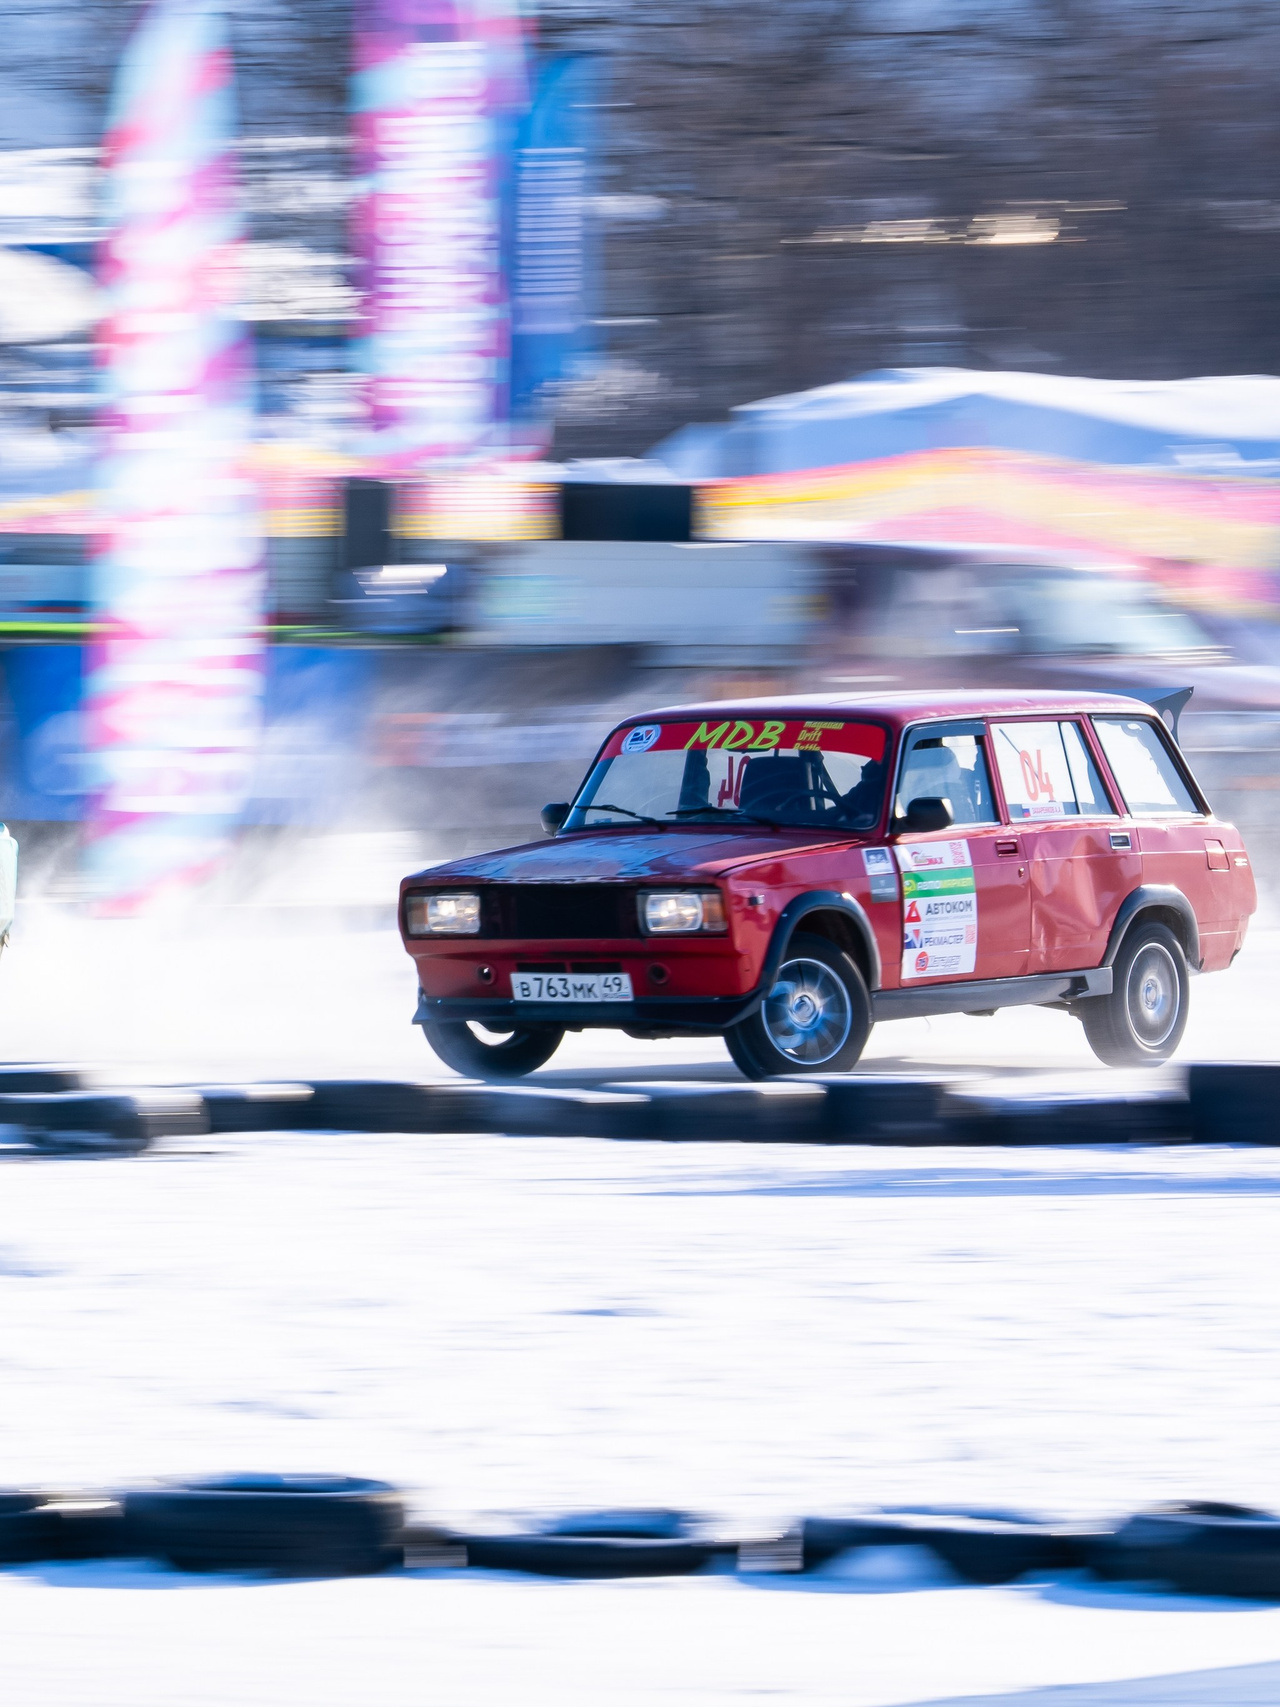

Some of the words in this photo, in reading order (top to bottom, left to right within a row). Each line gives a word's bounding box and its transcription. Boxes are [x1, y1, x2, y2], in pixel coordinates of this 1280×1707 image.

[684, 720, 786, 750] MDB
[797, 729, 823, 742] Drift
[1020, 749, 1054, 801] 04
[925, 900, 973, 916] АВТОКОМ
[603, 976, 622, 992] 49
